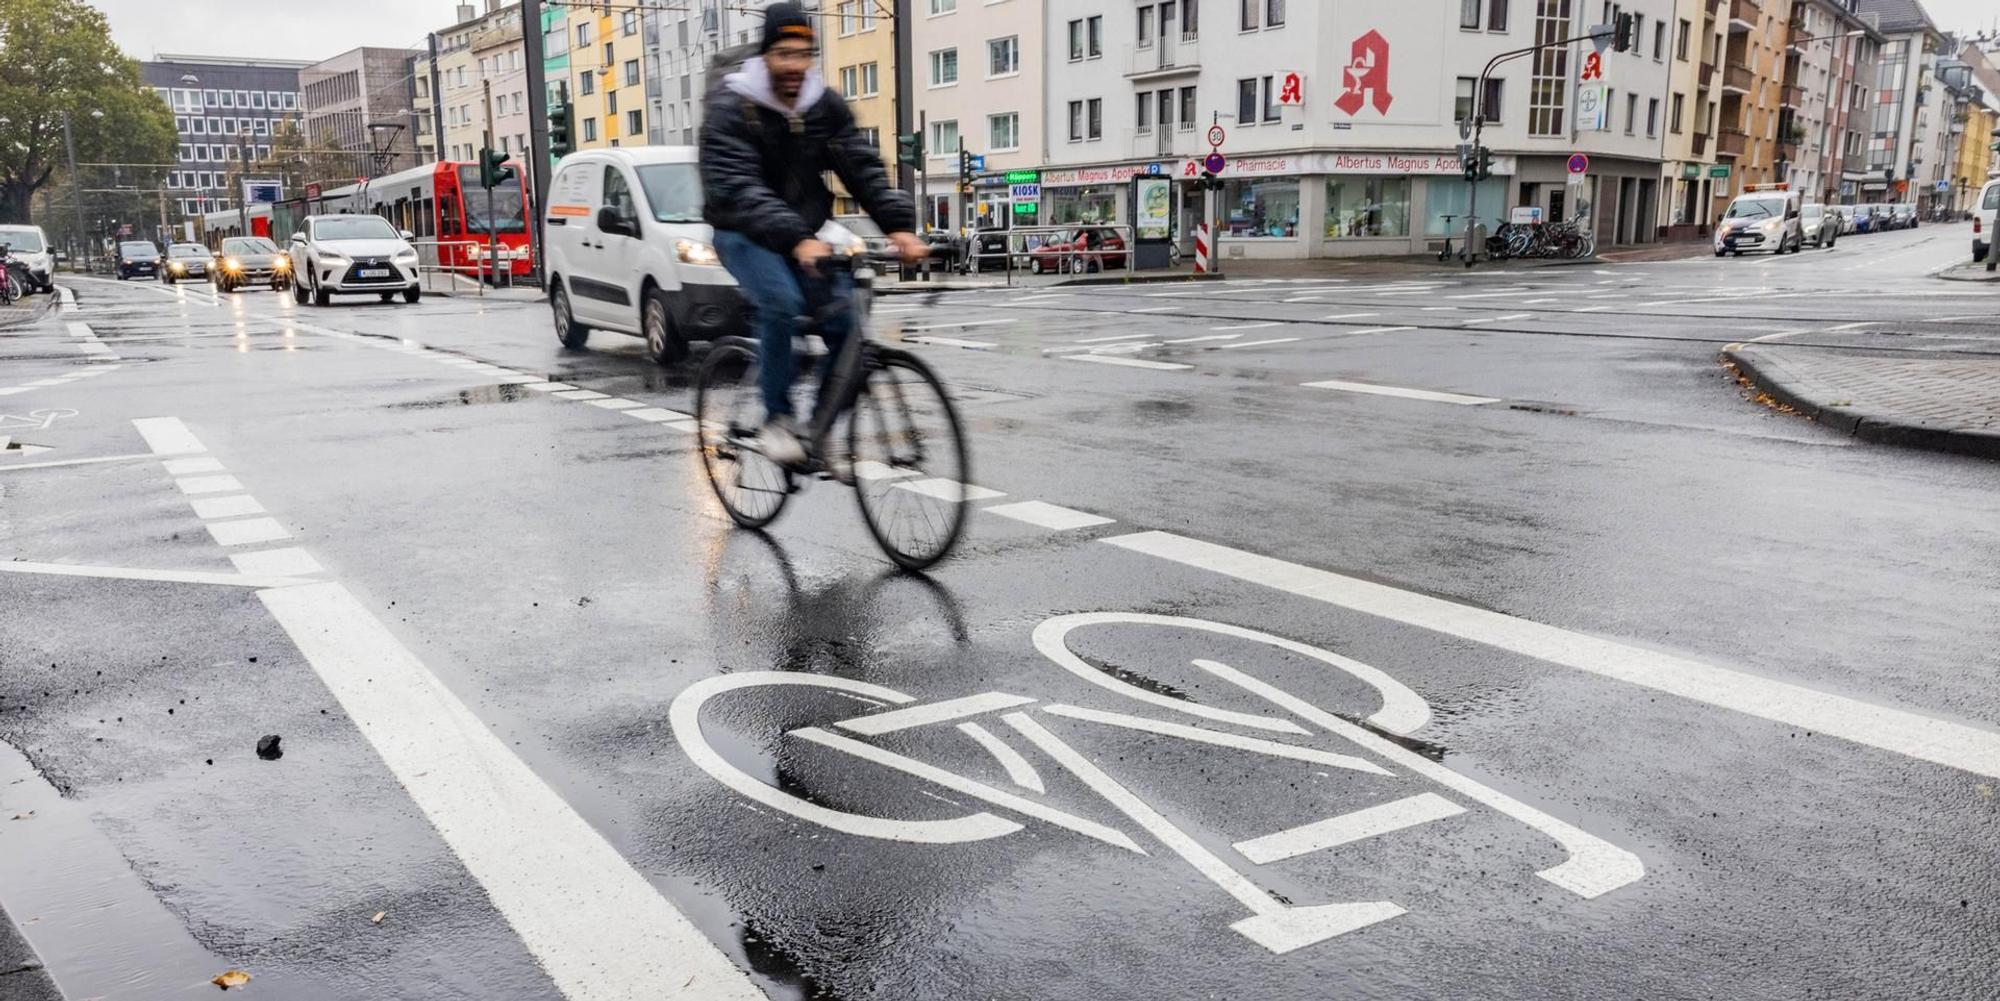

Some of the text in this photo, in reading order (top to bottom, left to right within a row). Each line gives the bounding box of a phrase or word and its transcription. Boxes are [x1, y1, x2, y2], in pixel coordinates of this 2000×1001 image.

[1211, 130, 1222, 142] 30
[1236, 159, 1286, 172] Pharmacie
[1335, 155, 1381, 169] Albertus
[1387, 157, 1429, 171] Magnus
[1045, 171, 1075, 183] Albertus
[1078, 167, 1108, 182] Magnus
[1012, 184, 1039, 196] KIOSK
